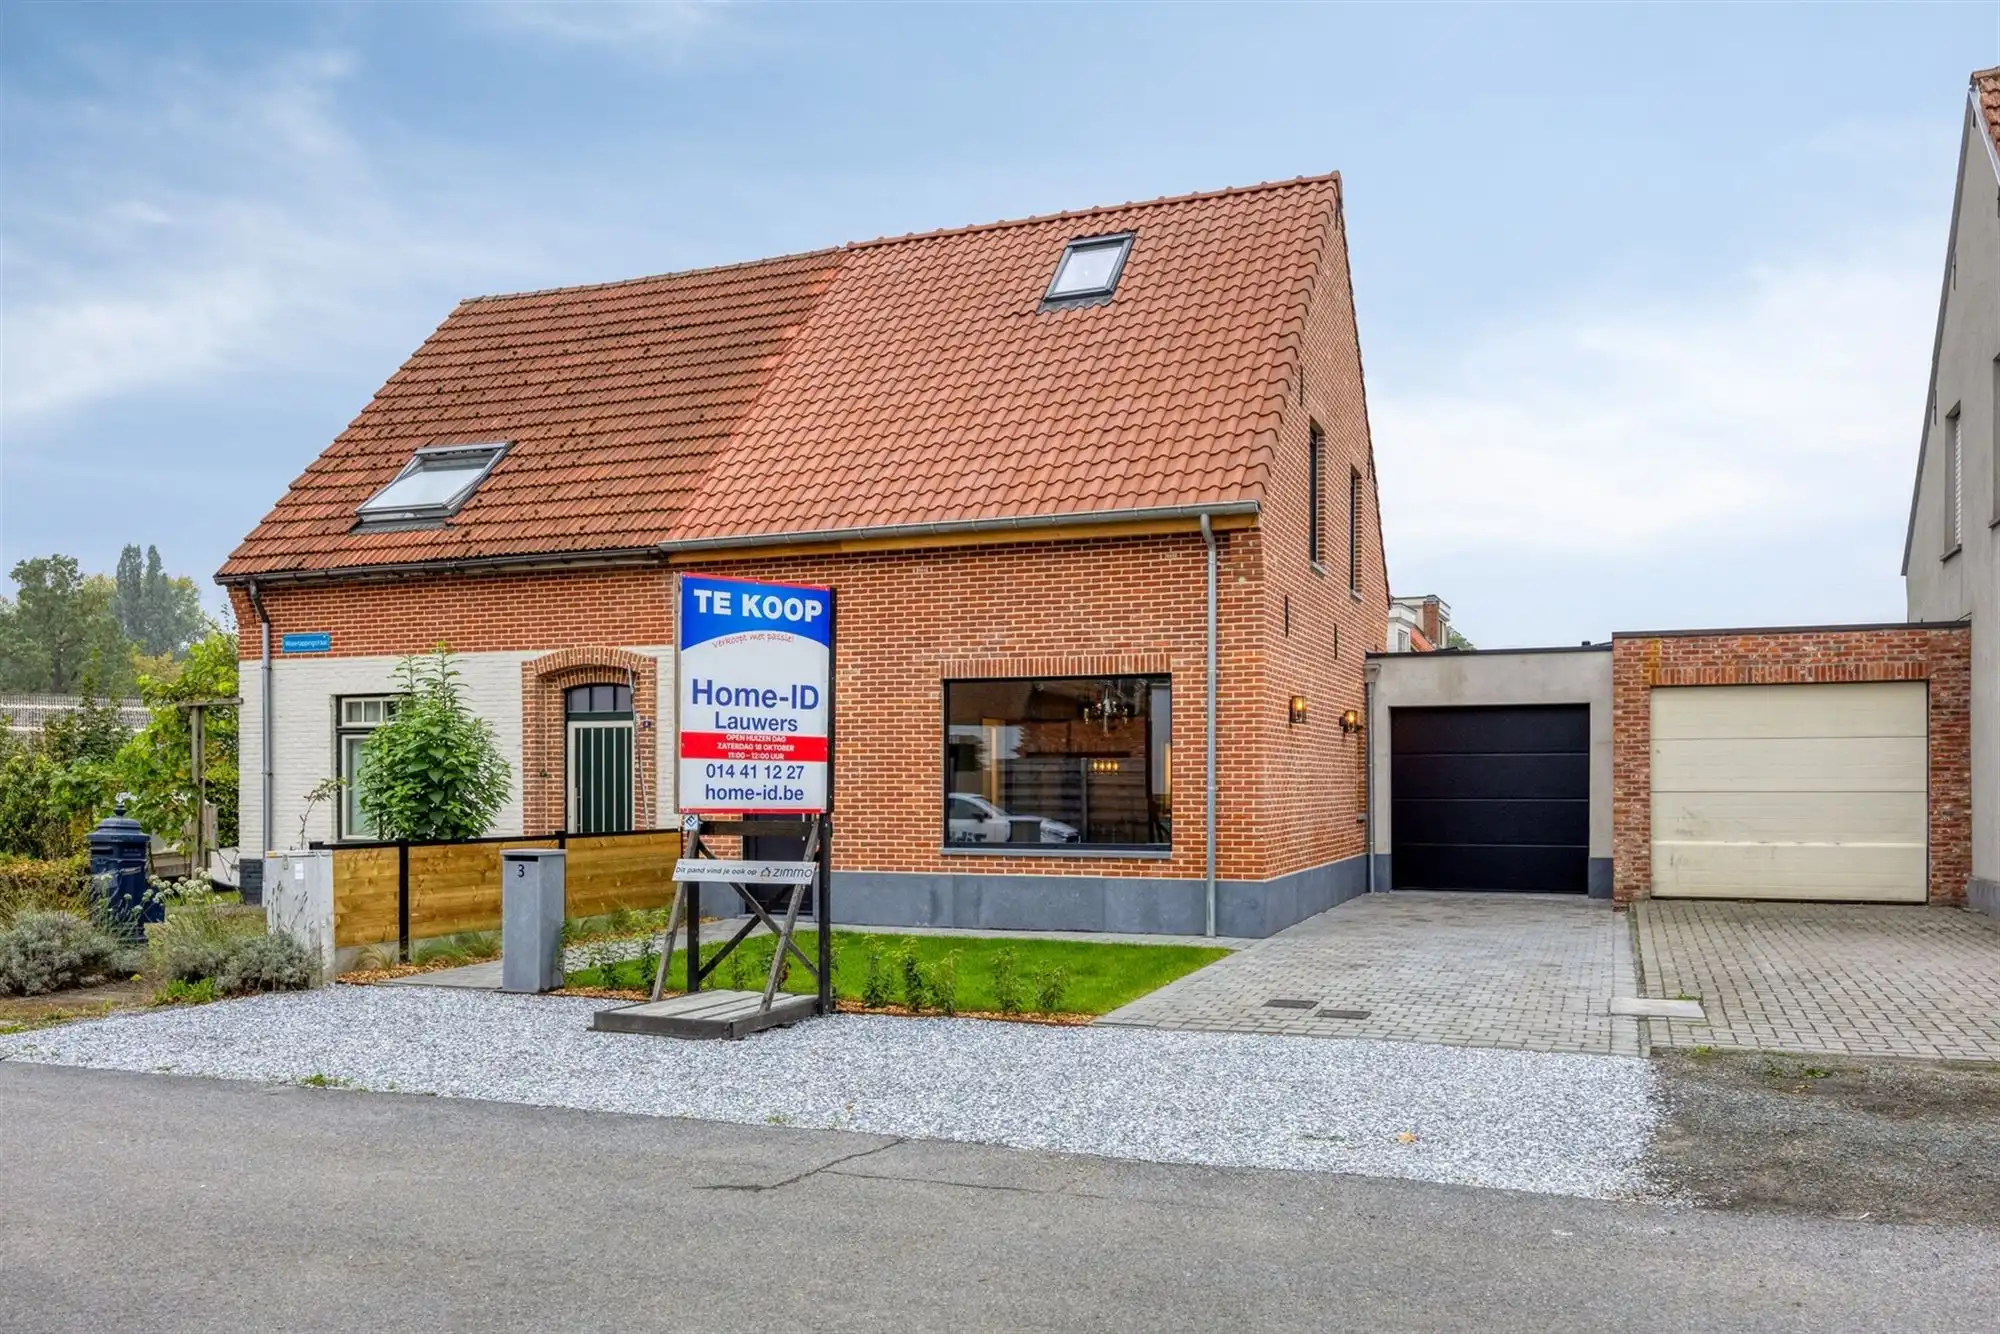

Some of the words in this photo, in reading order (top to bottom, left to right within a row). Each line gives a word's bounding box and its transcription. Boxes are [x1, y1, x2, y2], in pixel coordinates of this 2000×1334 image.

[693, 588, 732, 616] TE
[742, 593, 823, 623] KOOP
[692, 678, 820, 710] Home-ID
[714, 711, 798, 732] Lauwers
[717, 742, 754, 750] ZATERDAG
[763, 744, 795, 752] OKTOBER
[706, 763, 735, 779] 014
[740, 764, 757, 779] 41
[764, 765, 782, 780] 12
[786, 765, 805, 780] 27
[705, 784, 804, 801] home-id.be
[517, 864, 525, 878] 3
[687, 866, 706, 875] pand
[706, 866, 722, 874] vind
[723, 866, 730, 876] je
[732, 867, 745, 875] ook
[747, 869, 757, 877] op
[773, 866, 813, 878] zimmo
